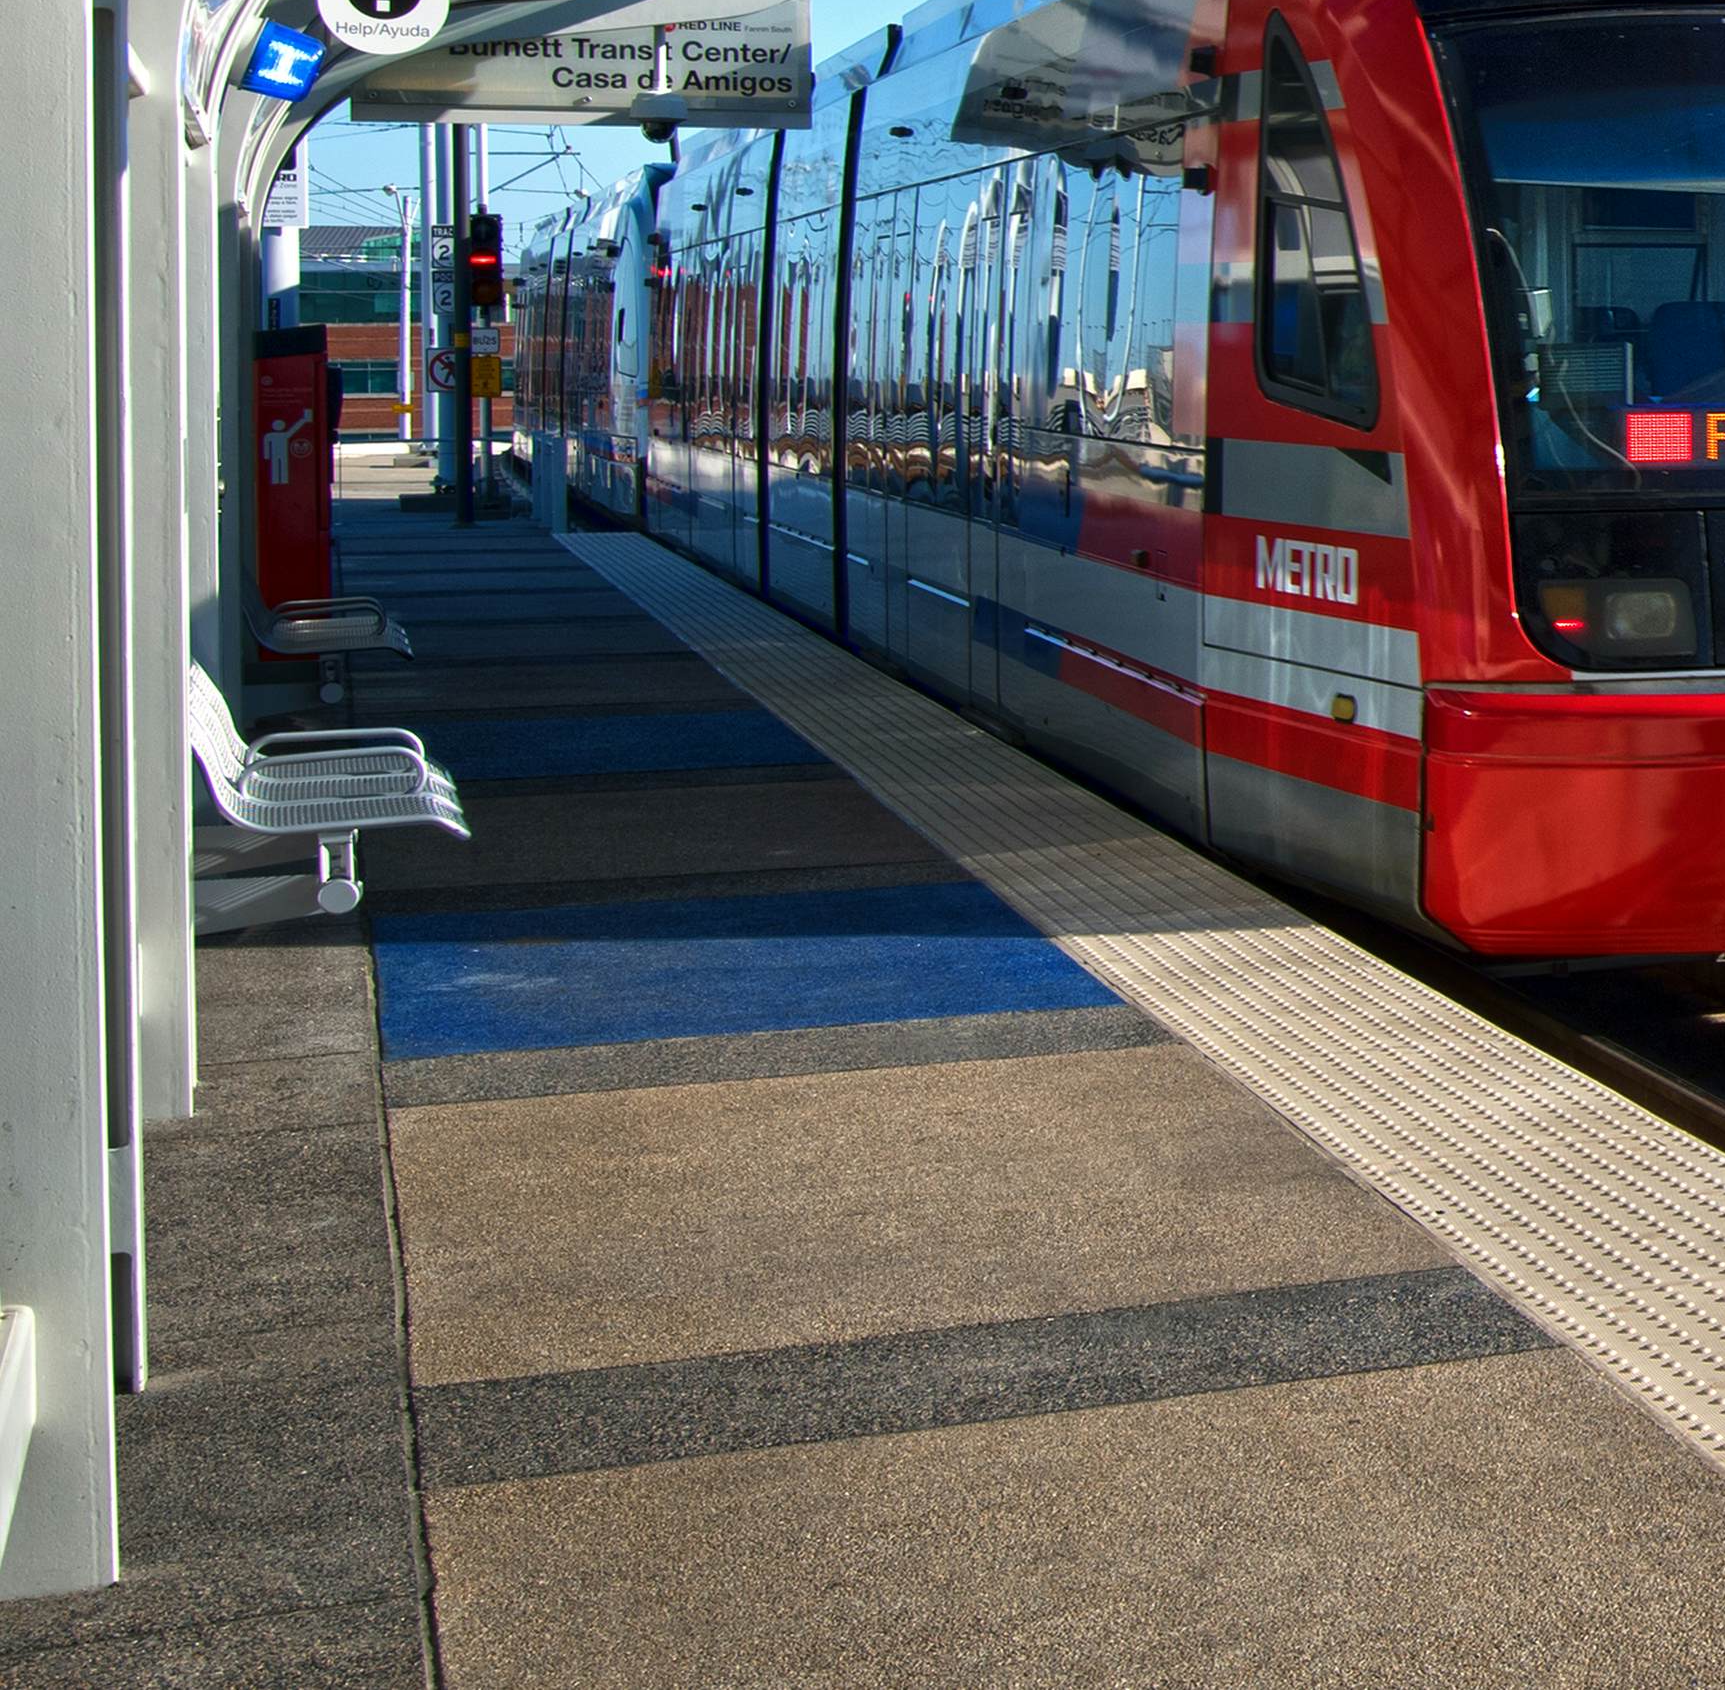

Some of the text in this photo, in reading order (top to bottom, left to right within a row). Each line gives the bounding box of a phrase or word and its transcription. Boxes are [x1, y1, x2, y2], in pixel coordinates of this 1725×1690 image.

[335, 20, 431, 39] Help/Ayuda
[678, 21, 707, 31] RED
[711, 21, 741, 32] LINE
[572, 38, 673, 61] Transt
[681, 40, 793, 64] Center/
[552, 67, 627, 89] Casa
[682, 69, 793, 95] Amigos
[1256, 535, 1358, 605] METRO
